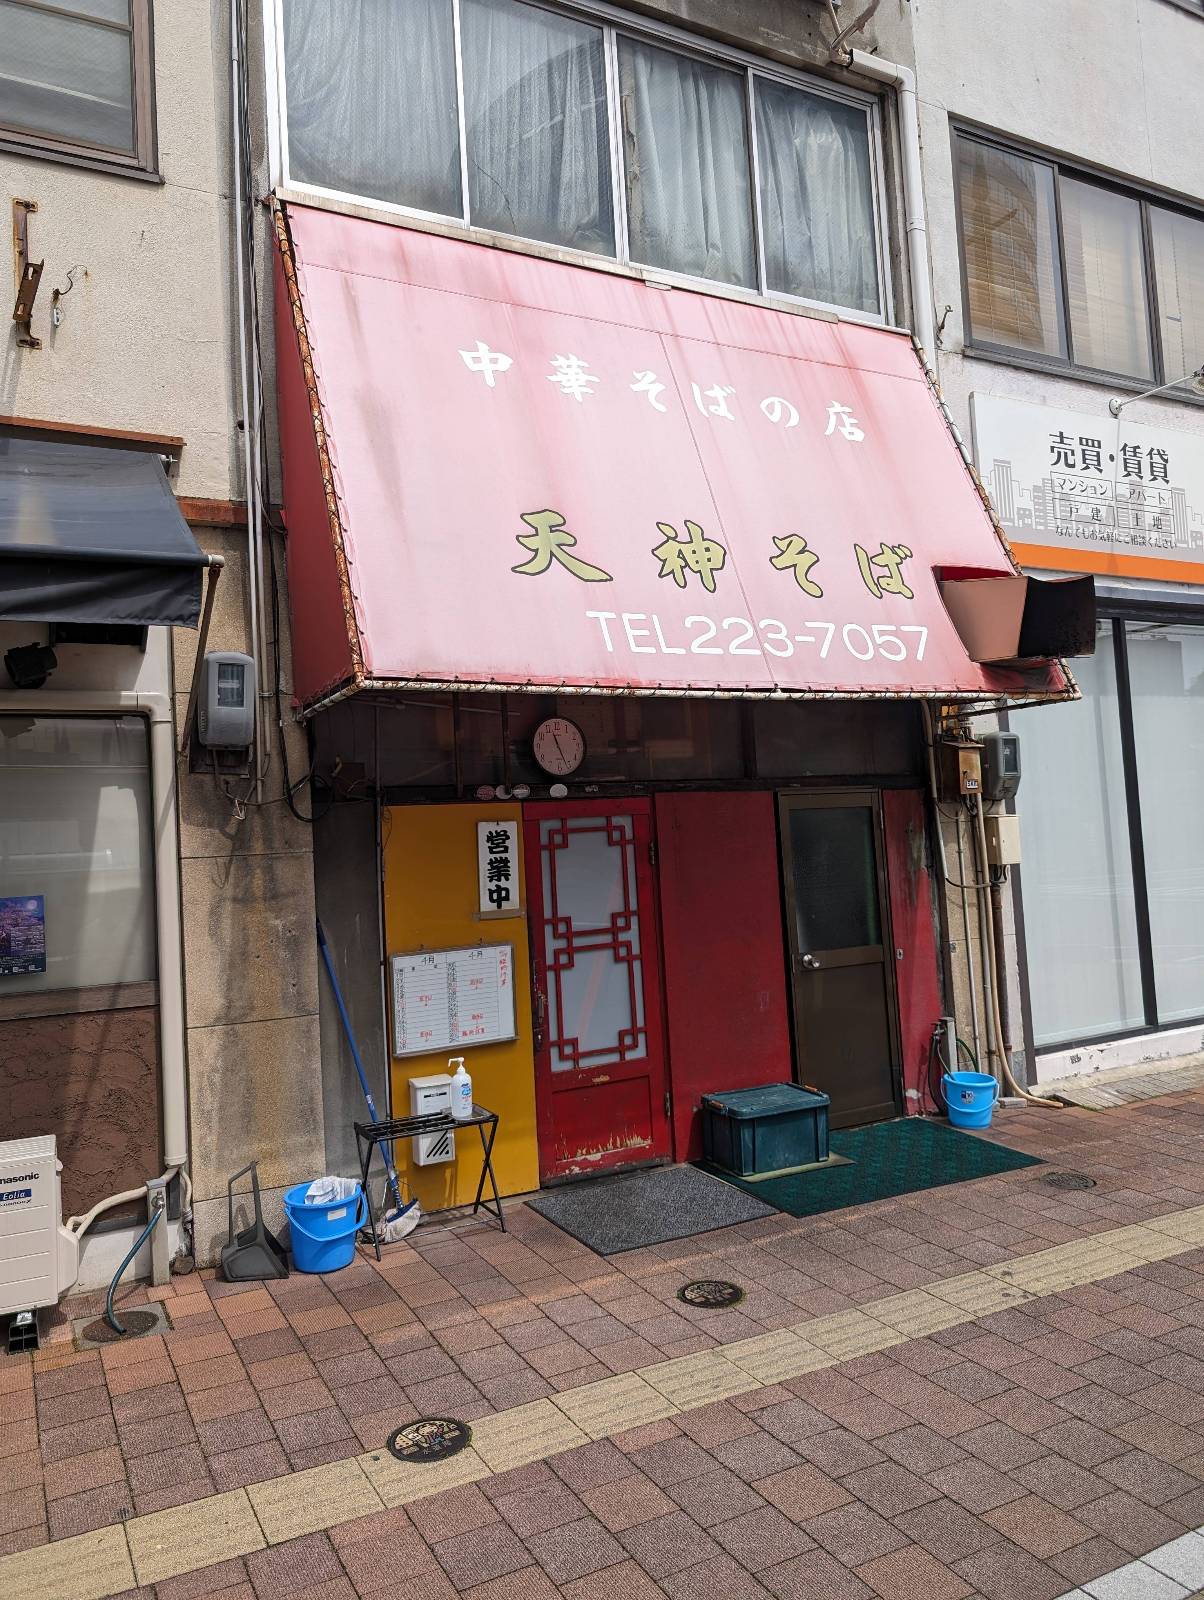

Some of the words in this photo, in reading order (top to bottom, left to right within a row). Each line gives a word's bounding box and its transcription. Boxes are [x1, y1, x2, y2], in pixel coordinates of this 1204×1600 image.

[457, 340, 866, 443] 中華そばの店
[1049, 430, 1170, 485] 売買・賃貸
[1055, 477, 1108, 496] マンション
[510, 508, 915, 600] 天神そば
[486, 829, 512, 910] 営業中
[3, 1191, 26, 1200] Eolia
